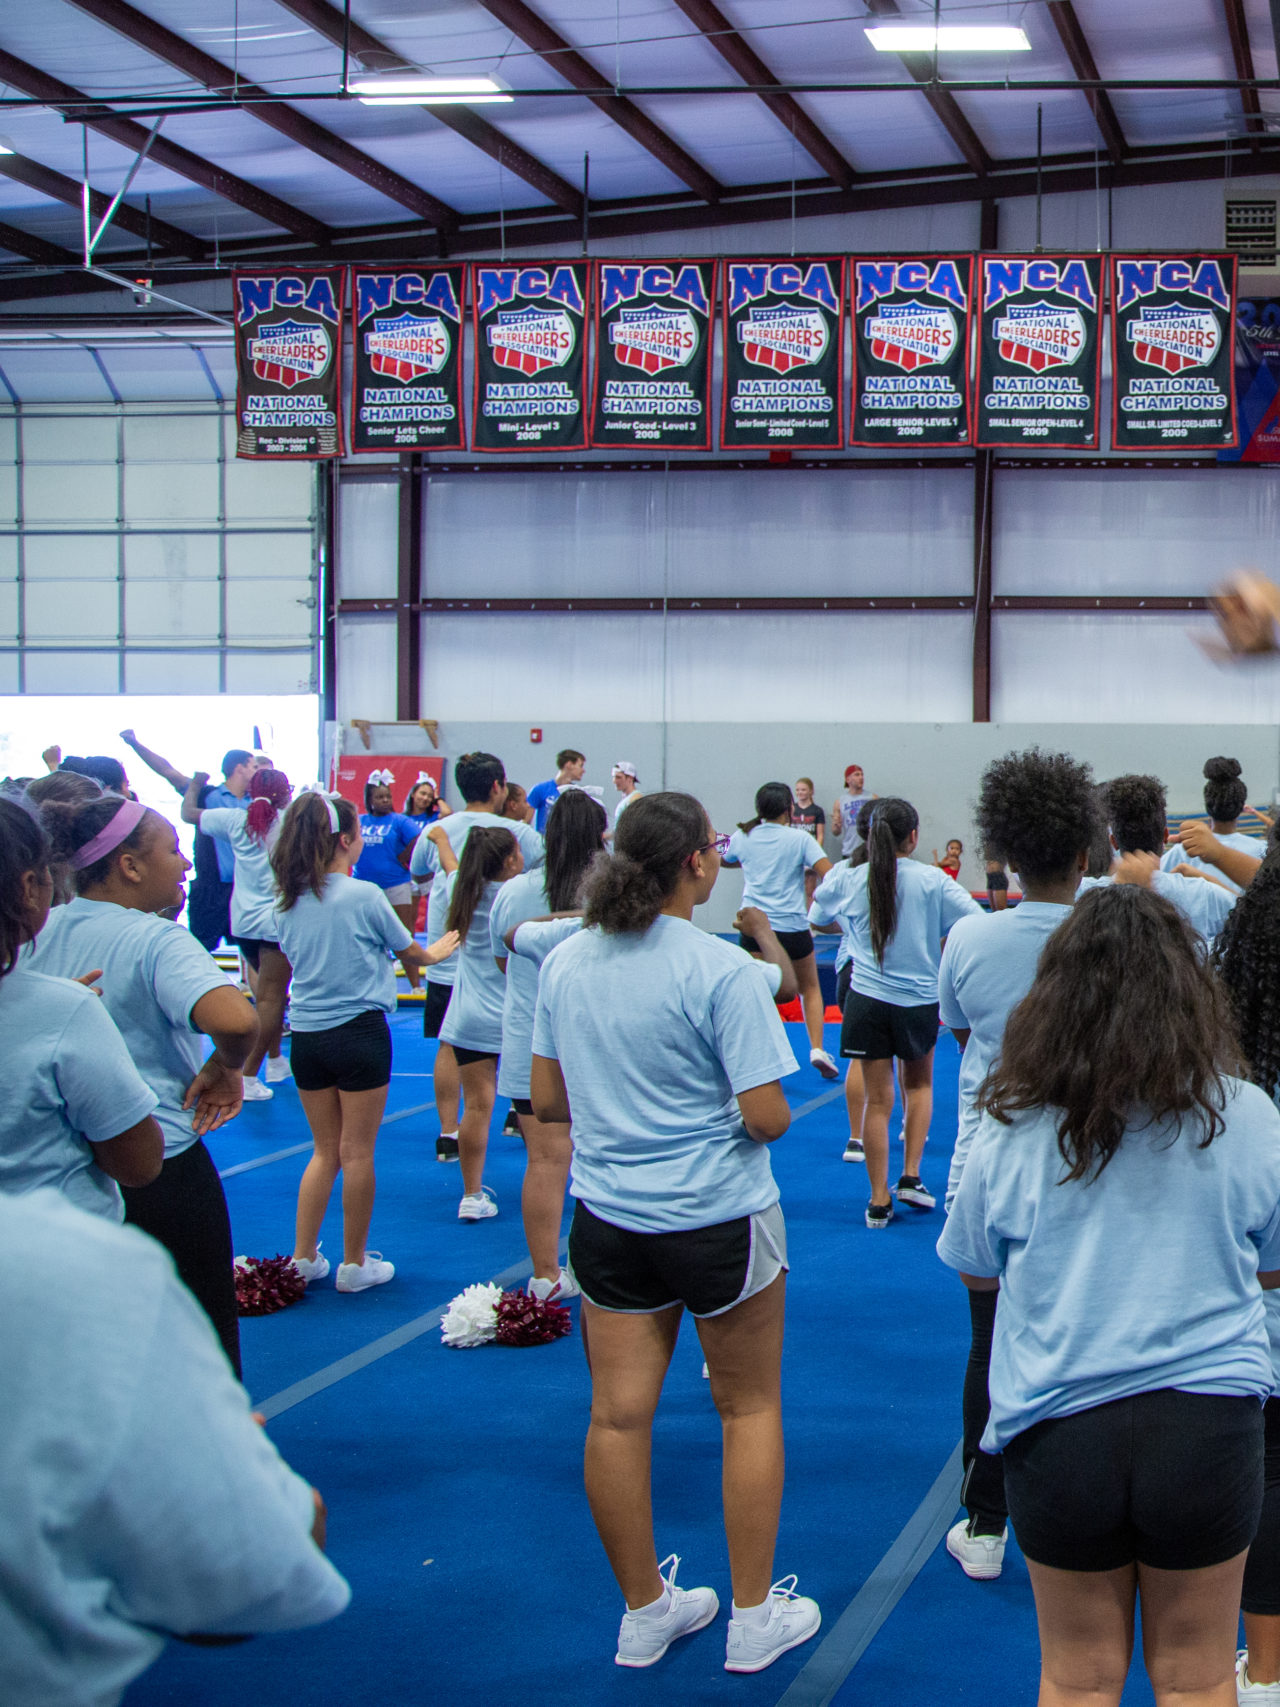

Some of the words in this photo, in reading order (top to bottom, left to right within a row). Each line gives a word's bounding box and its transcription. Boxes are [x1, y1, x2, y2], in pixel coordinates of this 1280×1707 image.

[478, 266, 584, 320] NCA
[601, 265, 709, 318] NCA
[729, 263, 839, 316] NCA
[856, 261, 967, 314] NCA
[984, 260, 1097, 313] NCA
[1117, 260, 1230, 312] NCA
[238, 276, 340, 327] NCA
[357, 273, 461, 327] NCA
[507, 319, 558, 332] NATIONAL
[629, 318, 681, 330] NATIONAL
[758, 316, 812, 328] NATIONAL
[886, 316, 940, 327] NATIONAL
[1015, 317, 1069, 328] NATIONAL
[1149, 318, 1204, 330] NATIONAL
[266, 332, 315, 345] NATIONAL
[383, 326, 432, 339] NATIONAL
[745, 329, 823, 347] CHEERLEADERS
[872, 326, 952, 346] CHEERLEADERS
[1000, 327, 1080, 347] CHEERLEADERS
[1134, 329, 1215, 348] CHEERLEADERS
[1245, 325, 1273, 338] 5th
[370, 338, 444, 354] CHEERLEADERS
[493, 332, 570, 348] CHEERLEADERS
[615, 331, 694, 349] CHEERLEADERS
[753, 338, 810, 357] ASSOCIATION
[881, 334, 938, 356] ASSOCIATION
[1008, 335, 1067, 357] ASSOCIATION
[1143, 338, 1202, 358] ASSOCIATION
[254, 344, 327, 361] CHEERLEADERS
[377, 348, 432, 365] ASSOCIATION
[501, 341, 557, 359] ASSOCIATION
[622, 340, 680, 359] ASSOCIATION
[262, 354, 314, 370] ASSOCIATION
[486, 382, 573, 399] NATIONAL
[606, 381, 694, 398] NATIONAL
[737, 379, 825, 396] NATIONAL
[865, 376, 955, 392] NATIONAL
[993, 376, 1083, 393] NATIONAL
[1130, 378, 1220, 394] NATIONAL
[248, 395, 327, 410] NATIONAL
[364, 387, 448, 404] NATIONAL
[861, 393, 961, 409] CHAMPIONS
[985, 394, 1090, 410] CHAMPIONS
[1121, 394, 1227, 411] CHAMPIONS
[482, 399, 579, 416] CHAMPIONS
[602, 399, 702, 415] CHAMPIONS
[731, 396, 832, 412] CHAMPIONS
[242, 412, 336, 426] CHAMPIONS
[360, 404, 455, 422] CHAMPIONS
[498, 423, 519, 432] Mini
[525, 422, 552, 431] Level
[553, 422, 560, 430] 3
[604, 421, 632, 429] Junior
[632, 421, 657, 430] Coed
[662, 422, 688, 430] Level
[689, 422, 697, 430] 3
[864, 418, 891, 427] LARGE
[953, 417, 958, 426] 1
[367, 426, 396, 436] Senior
[419, 426, 446, 434] Cheer
[394, 434, 417, 443] 2006
[516, 432, 541, 440] 2008
[634, 430, 660, 439] 2008
[768, 428, 793, 436] 2008
[897, 427, 923, 436] 2009
[1022, 427, 1048, 436] 2009
[1161, 429, 1188, 437] 2009
